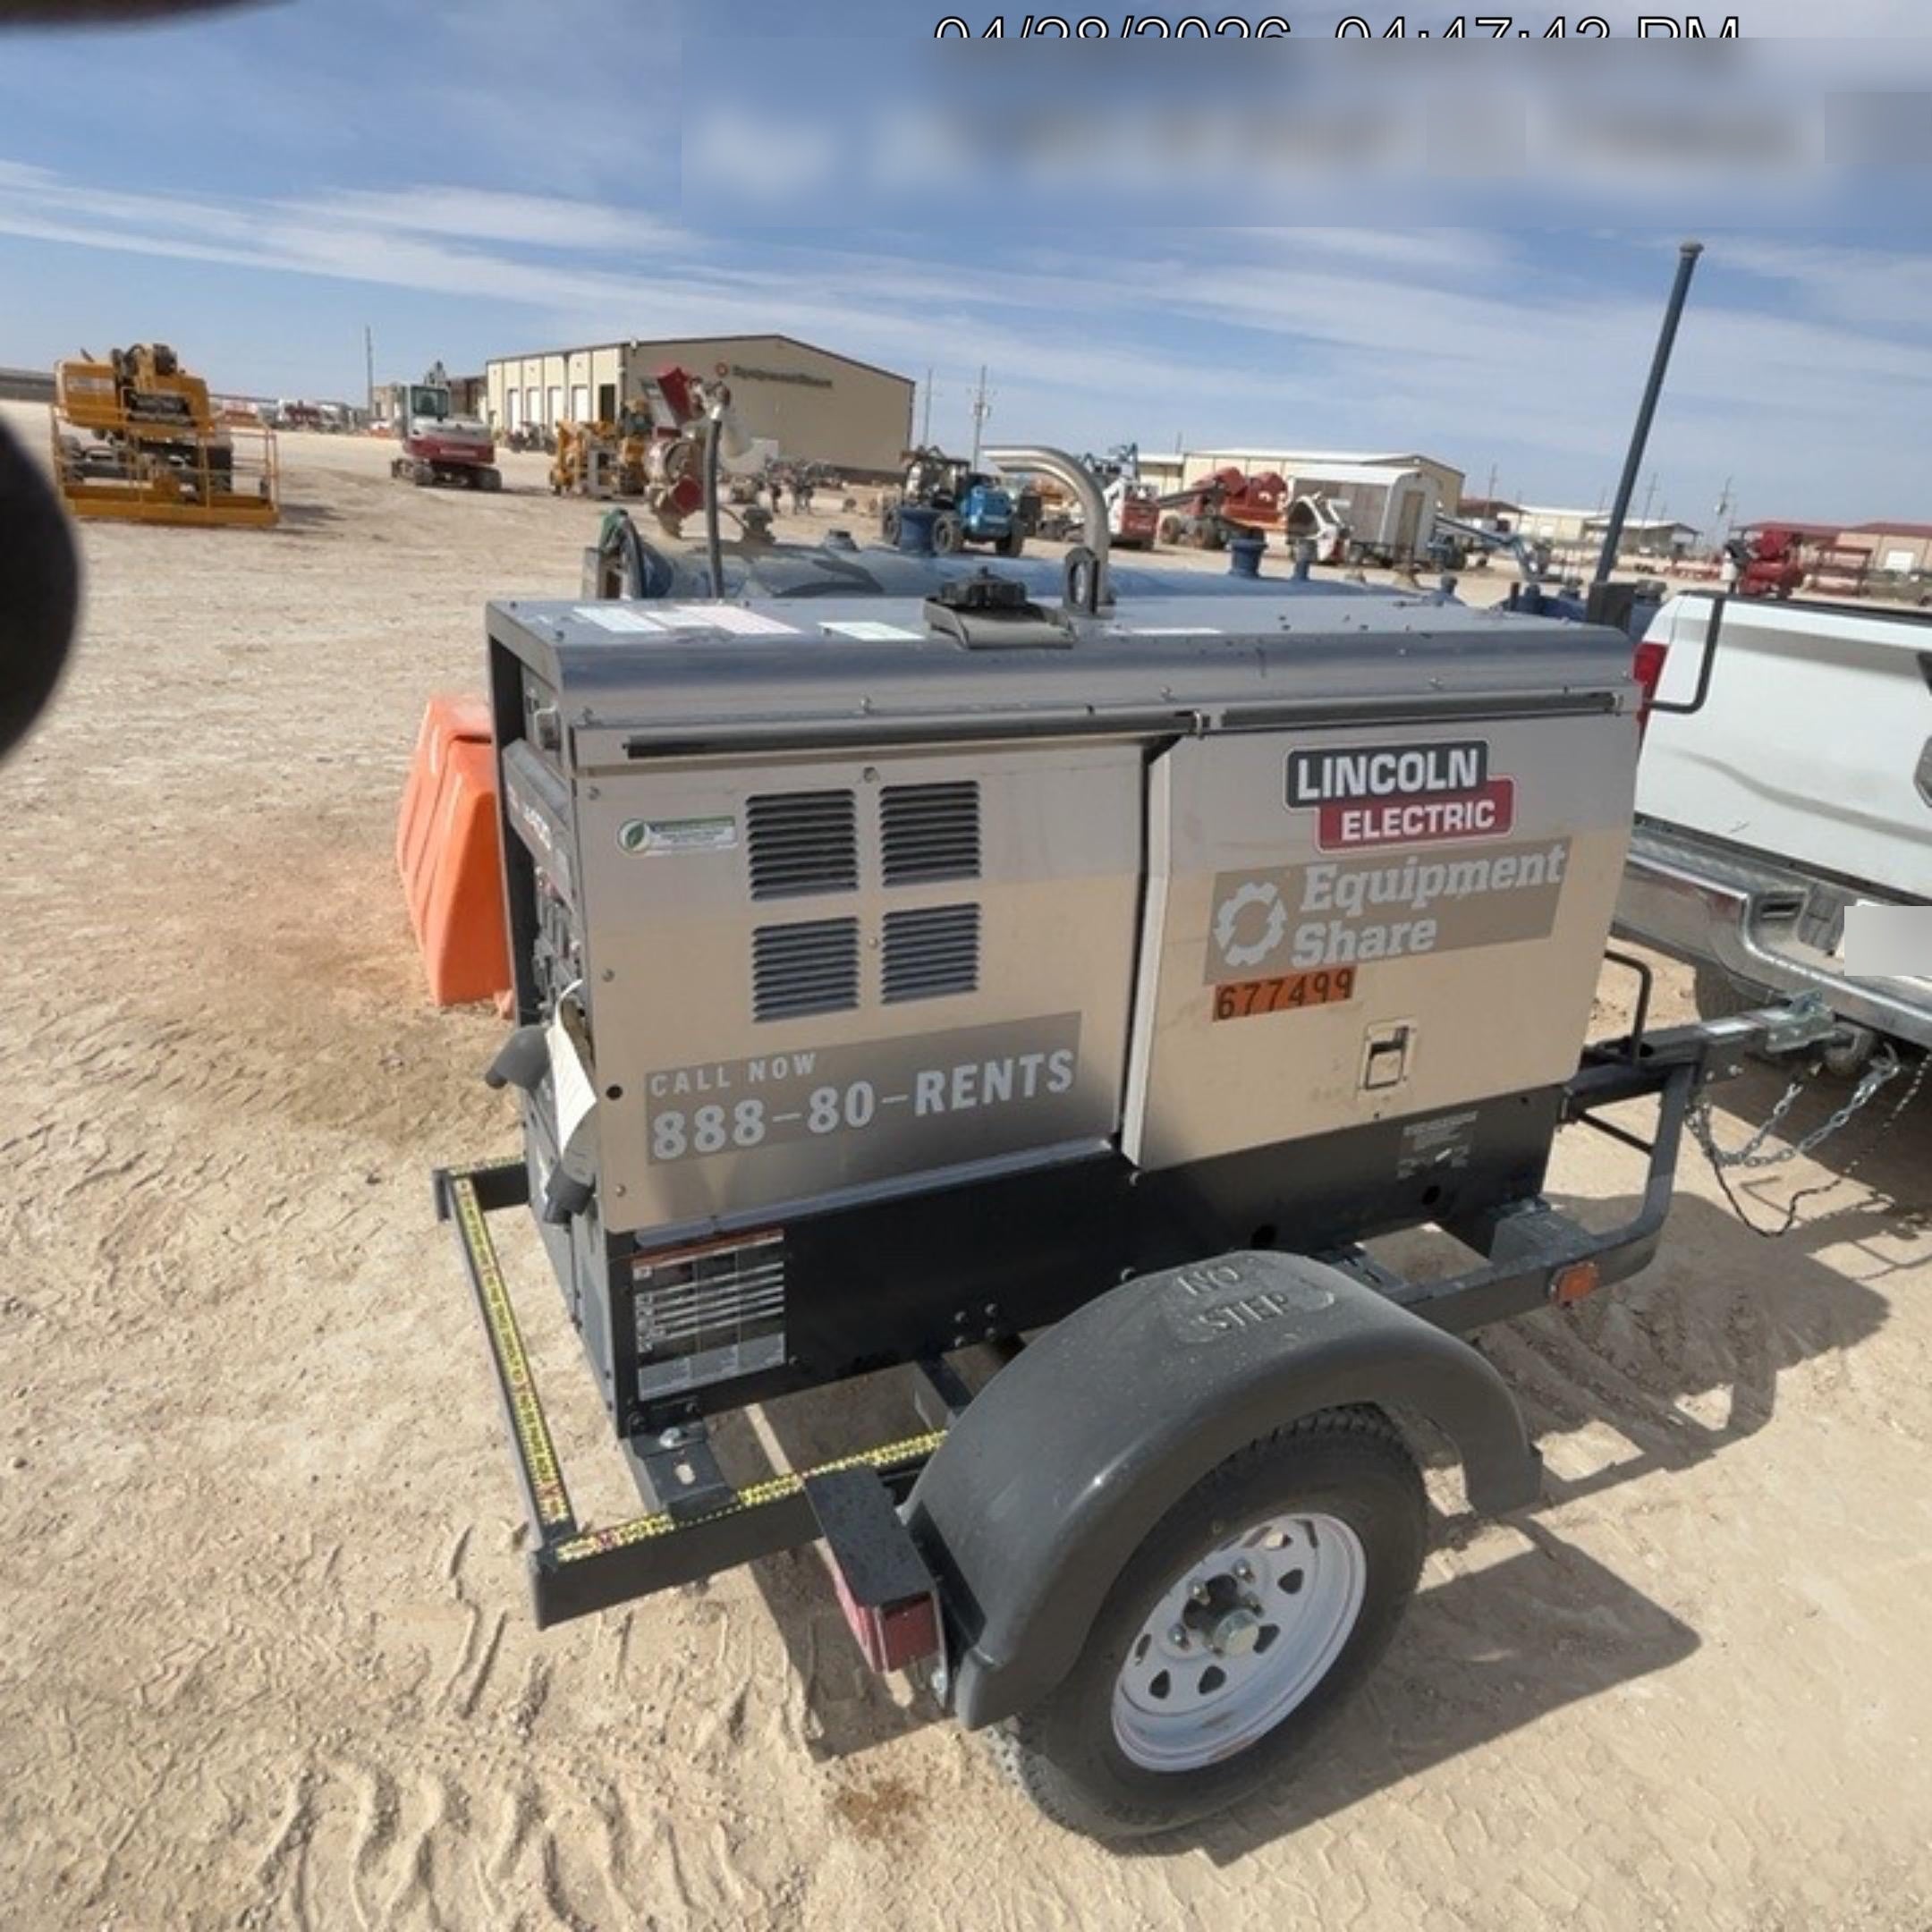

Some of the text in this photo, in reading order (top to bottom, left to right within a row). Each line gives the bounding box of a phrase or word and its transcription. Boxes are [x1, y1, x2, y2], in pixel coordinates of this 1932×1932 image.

[1297, 748, 1479, 801] LINCOLN
[1341, 800, 1496, 842] ELECTRIC
[1300, 843, 1566, 918] Equipment
[1290, 917, 1437, 968] Share
[1216, 966, 1353, 1021] 677499
[650, 1053, 817, 1097] CALL NOW
[652, 1048, 1075, 1160] 888-80-RENTS
[1176, 1265, 1241, 1296] NO
[1197, 1293, 1289, 1331] STEP
